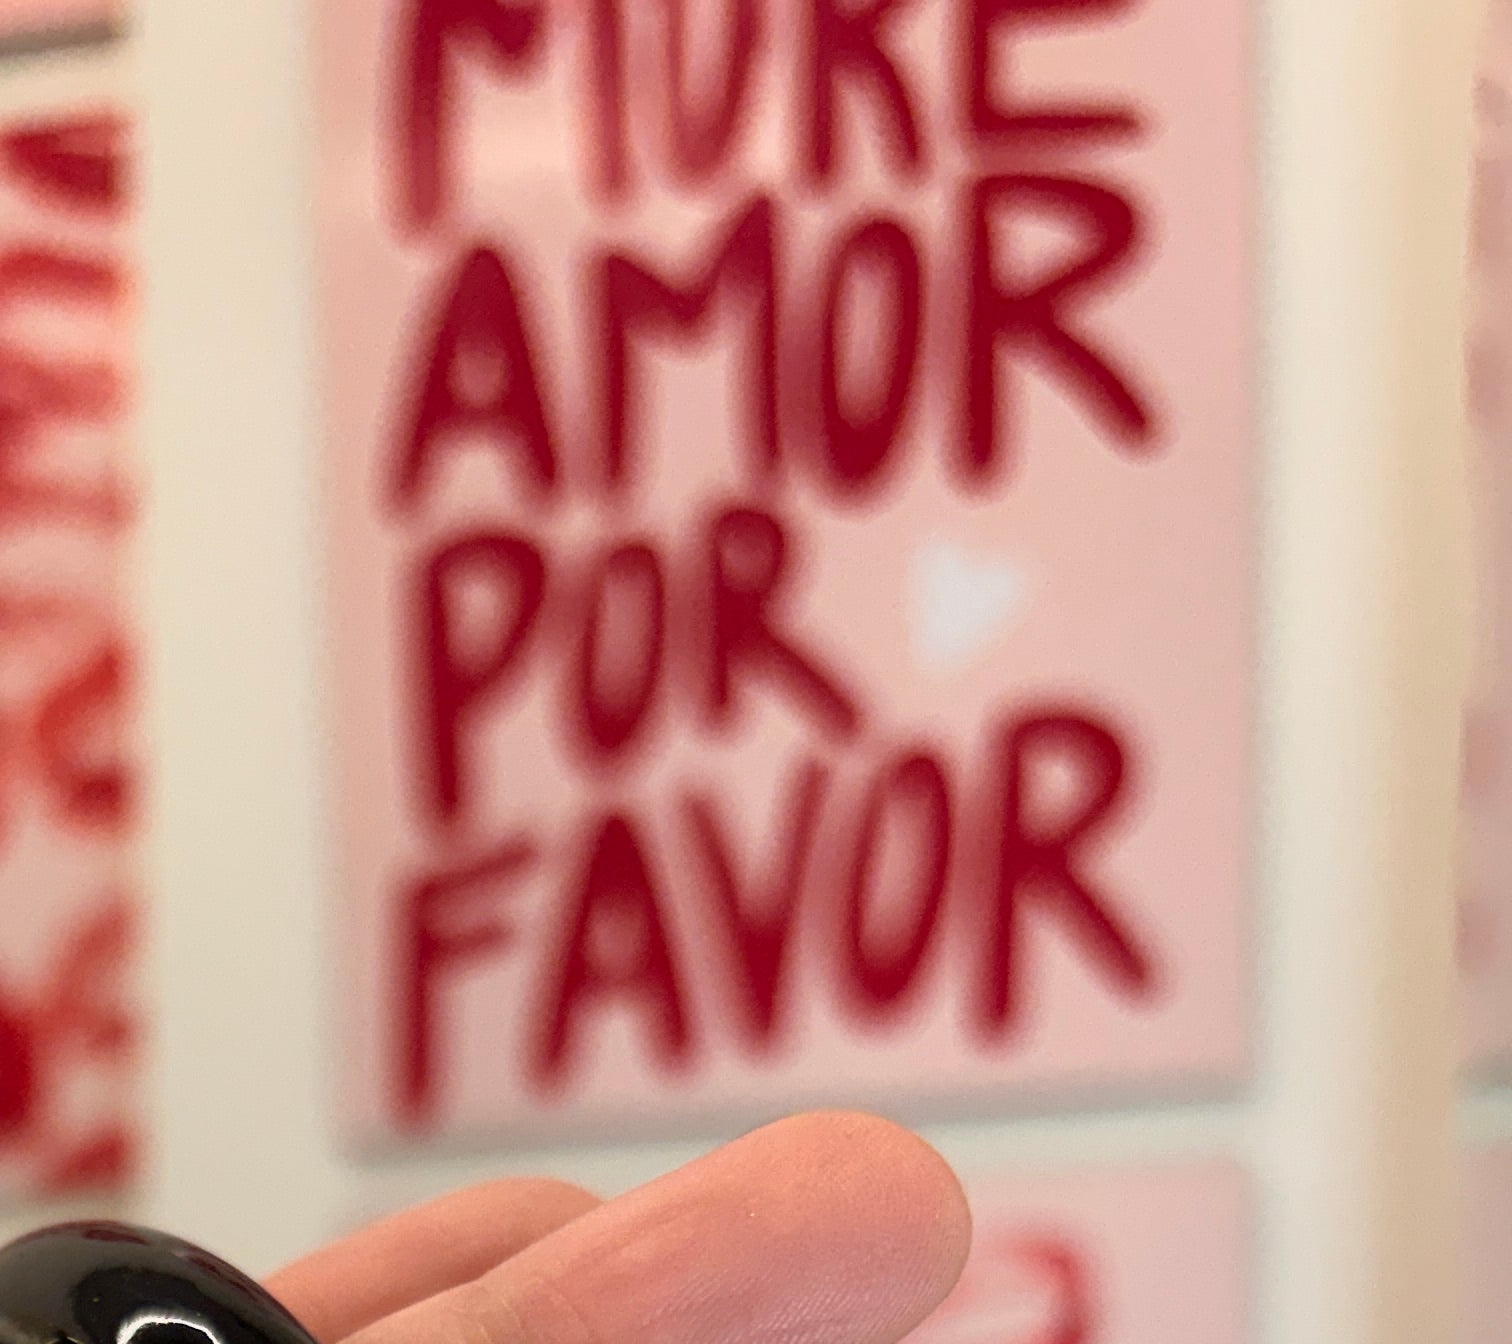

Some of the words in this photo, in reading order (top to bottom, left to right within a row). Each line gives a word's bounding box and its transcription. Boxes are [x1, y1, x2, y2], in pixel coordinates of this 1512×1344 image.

[384, 178, 1166, 508] AMOR
[410, 510, 862, 828] POR
[394, 702, 1158, 1134] FAVOR
